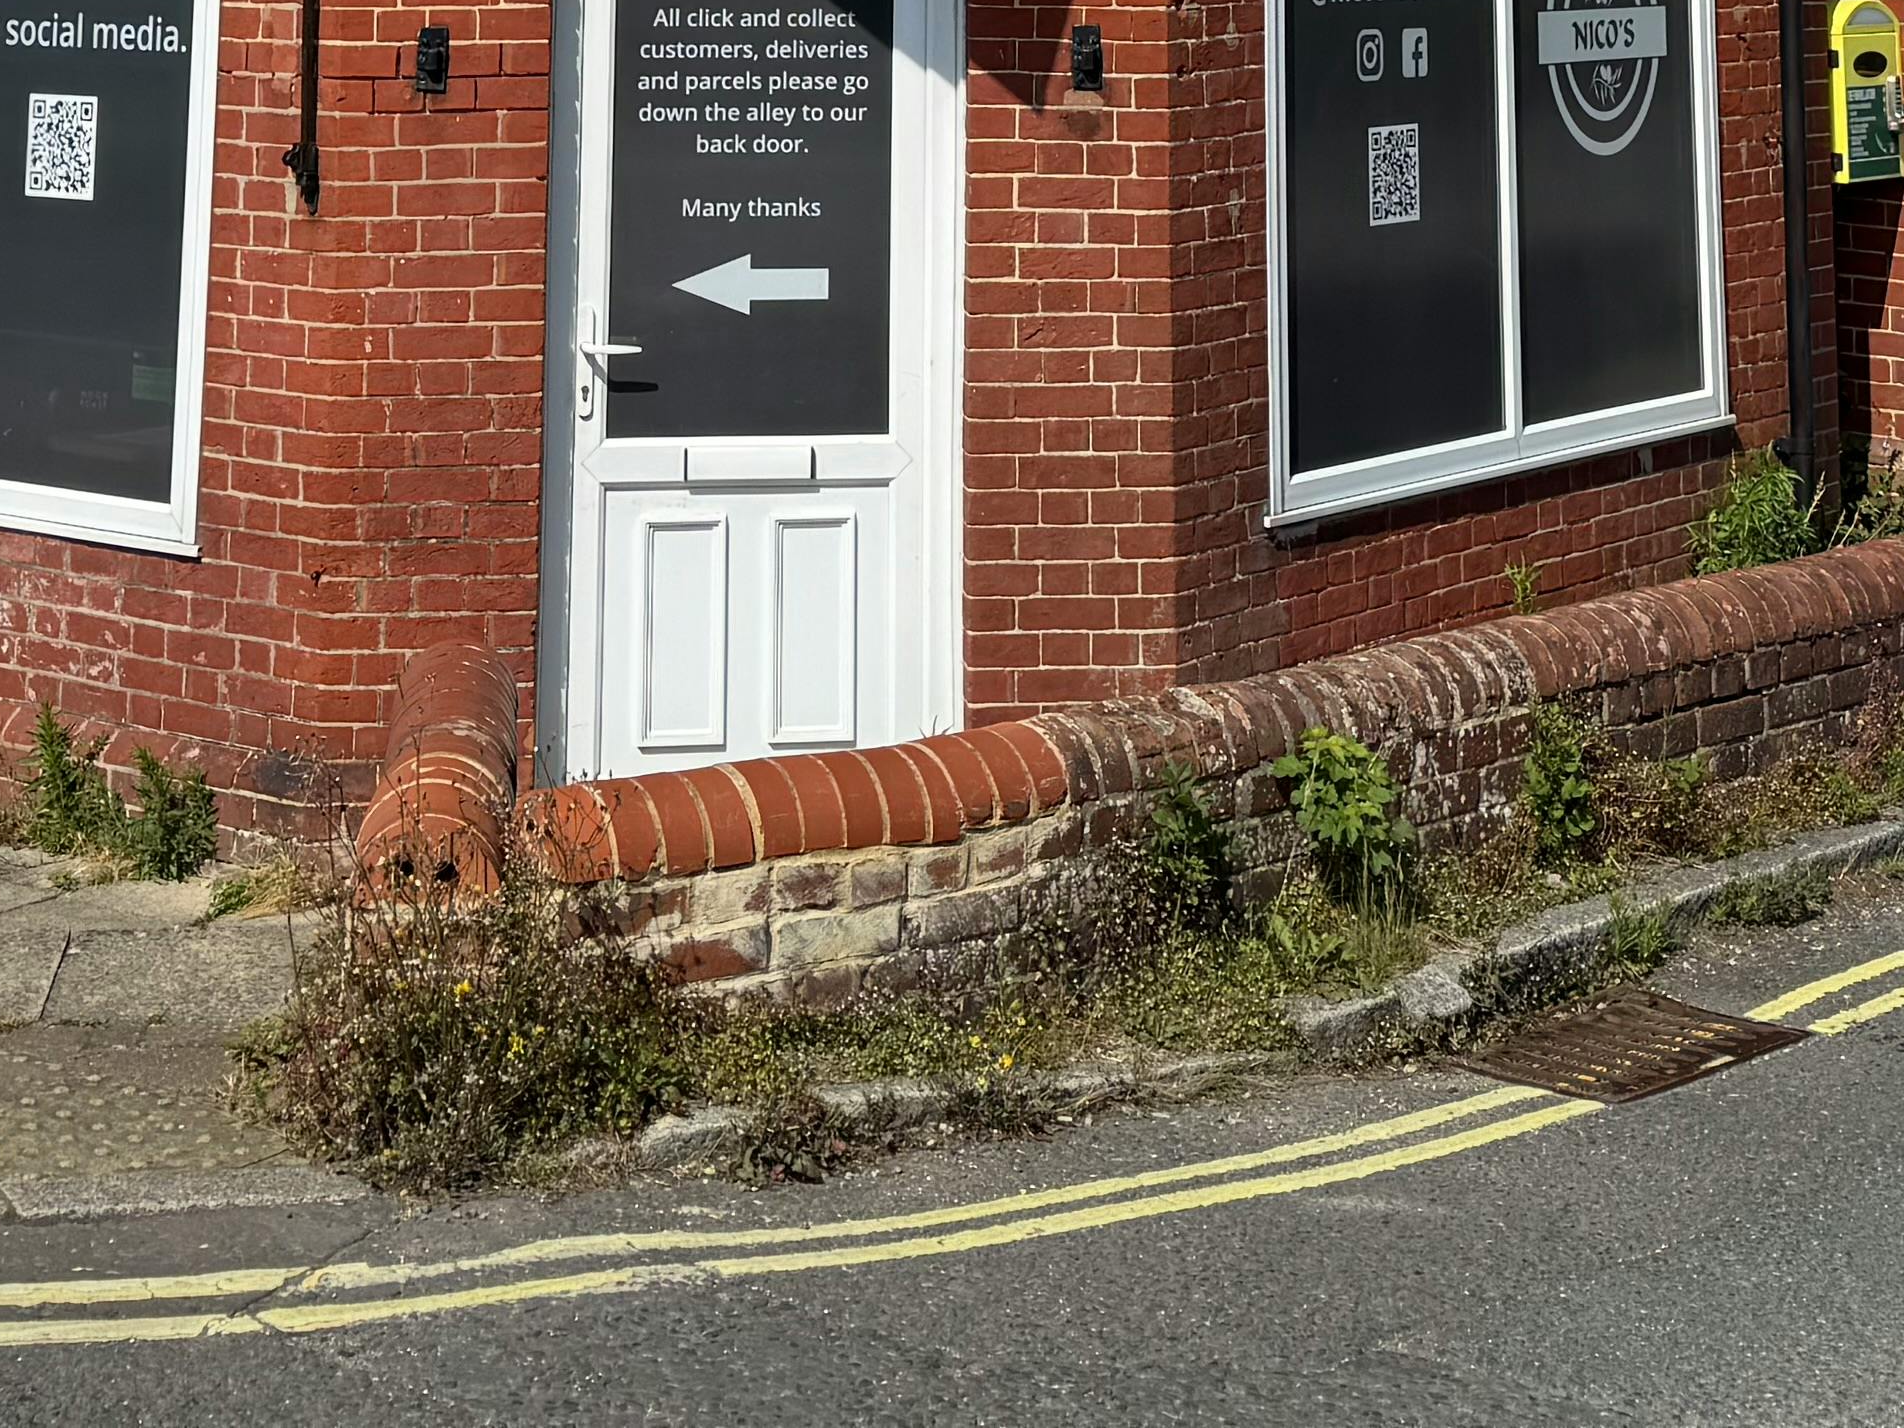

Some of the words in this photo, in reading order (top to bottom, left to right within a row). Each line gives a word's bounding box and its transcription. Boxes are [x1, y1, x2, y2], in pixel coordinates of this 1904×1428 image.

[653, 8, 680, 28] All
[686, 7, 734, 28] click
[740, 7, 781, 28] and
[786, 7, 856, 28] collect
[5, 12, 84, 48] social
[92, 15, 188, 53] media.
[1571, 18, 1636, 52] NICO'S
[639, 42, 759, 62] customers,
[765, 39, 869, 59] deliveries
[637, 70, 678, 90] and
[685, 70, 762, 95] parcels
[768, 70, 838, 95] please
[843, 76, 869, 95] go
[638, 102, 698, 122] down
[704, 102, 740, 122] the
[746, 102, 796, 127] alley
[802, 104, 824, 122] to
[830, 107, 867, 122] our
[696, 133, 746, 153] back
[752, 133, 809, 154] door.
[682, 198, 741, 222] Many
[748, 196, 821, 217] thanks
